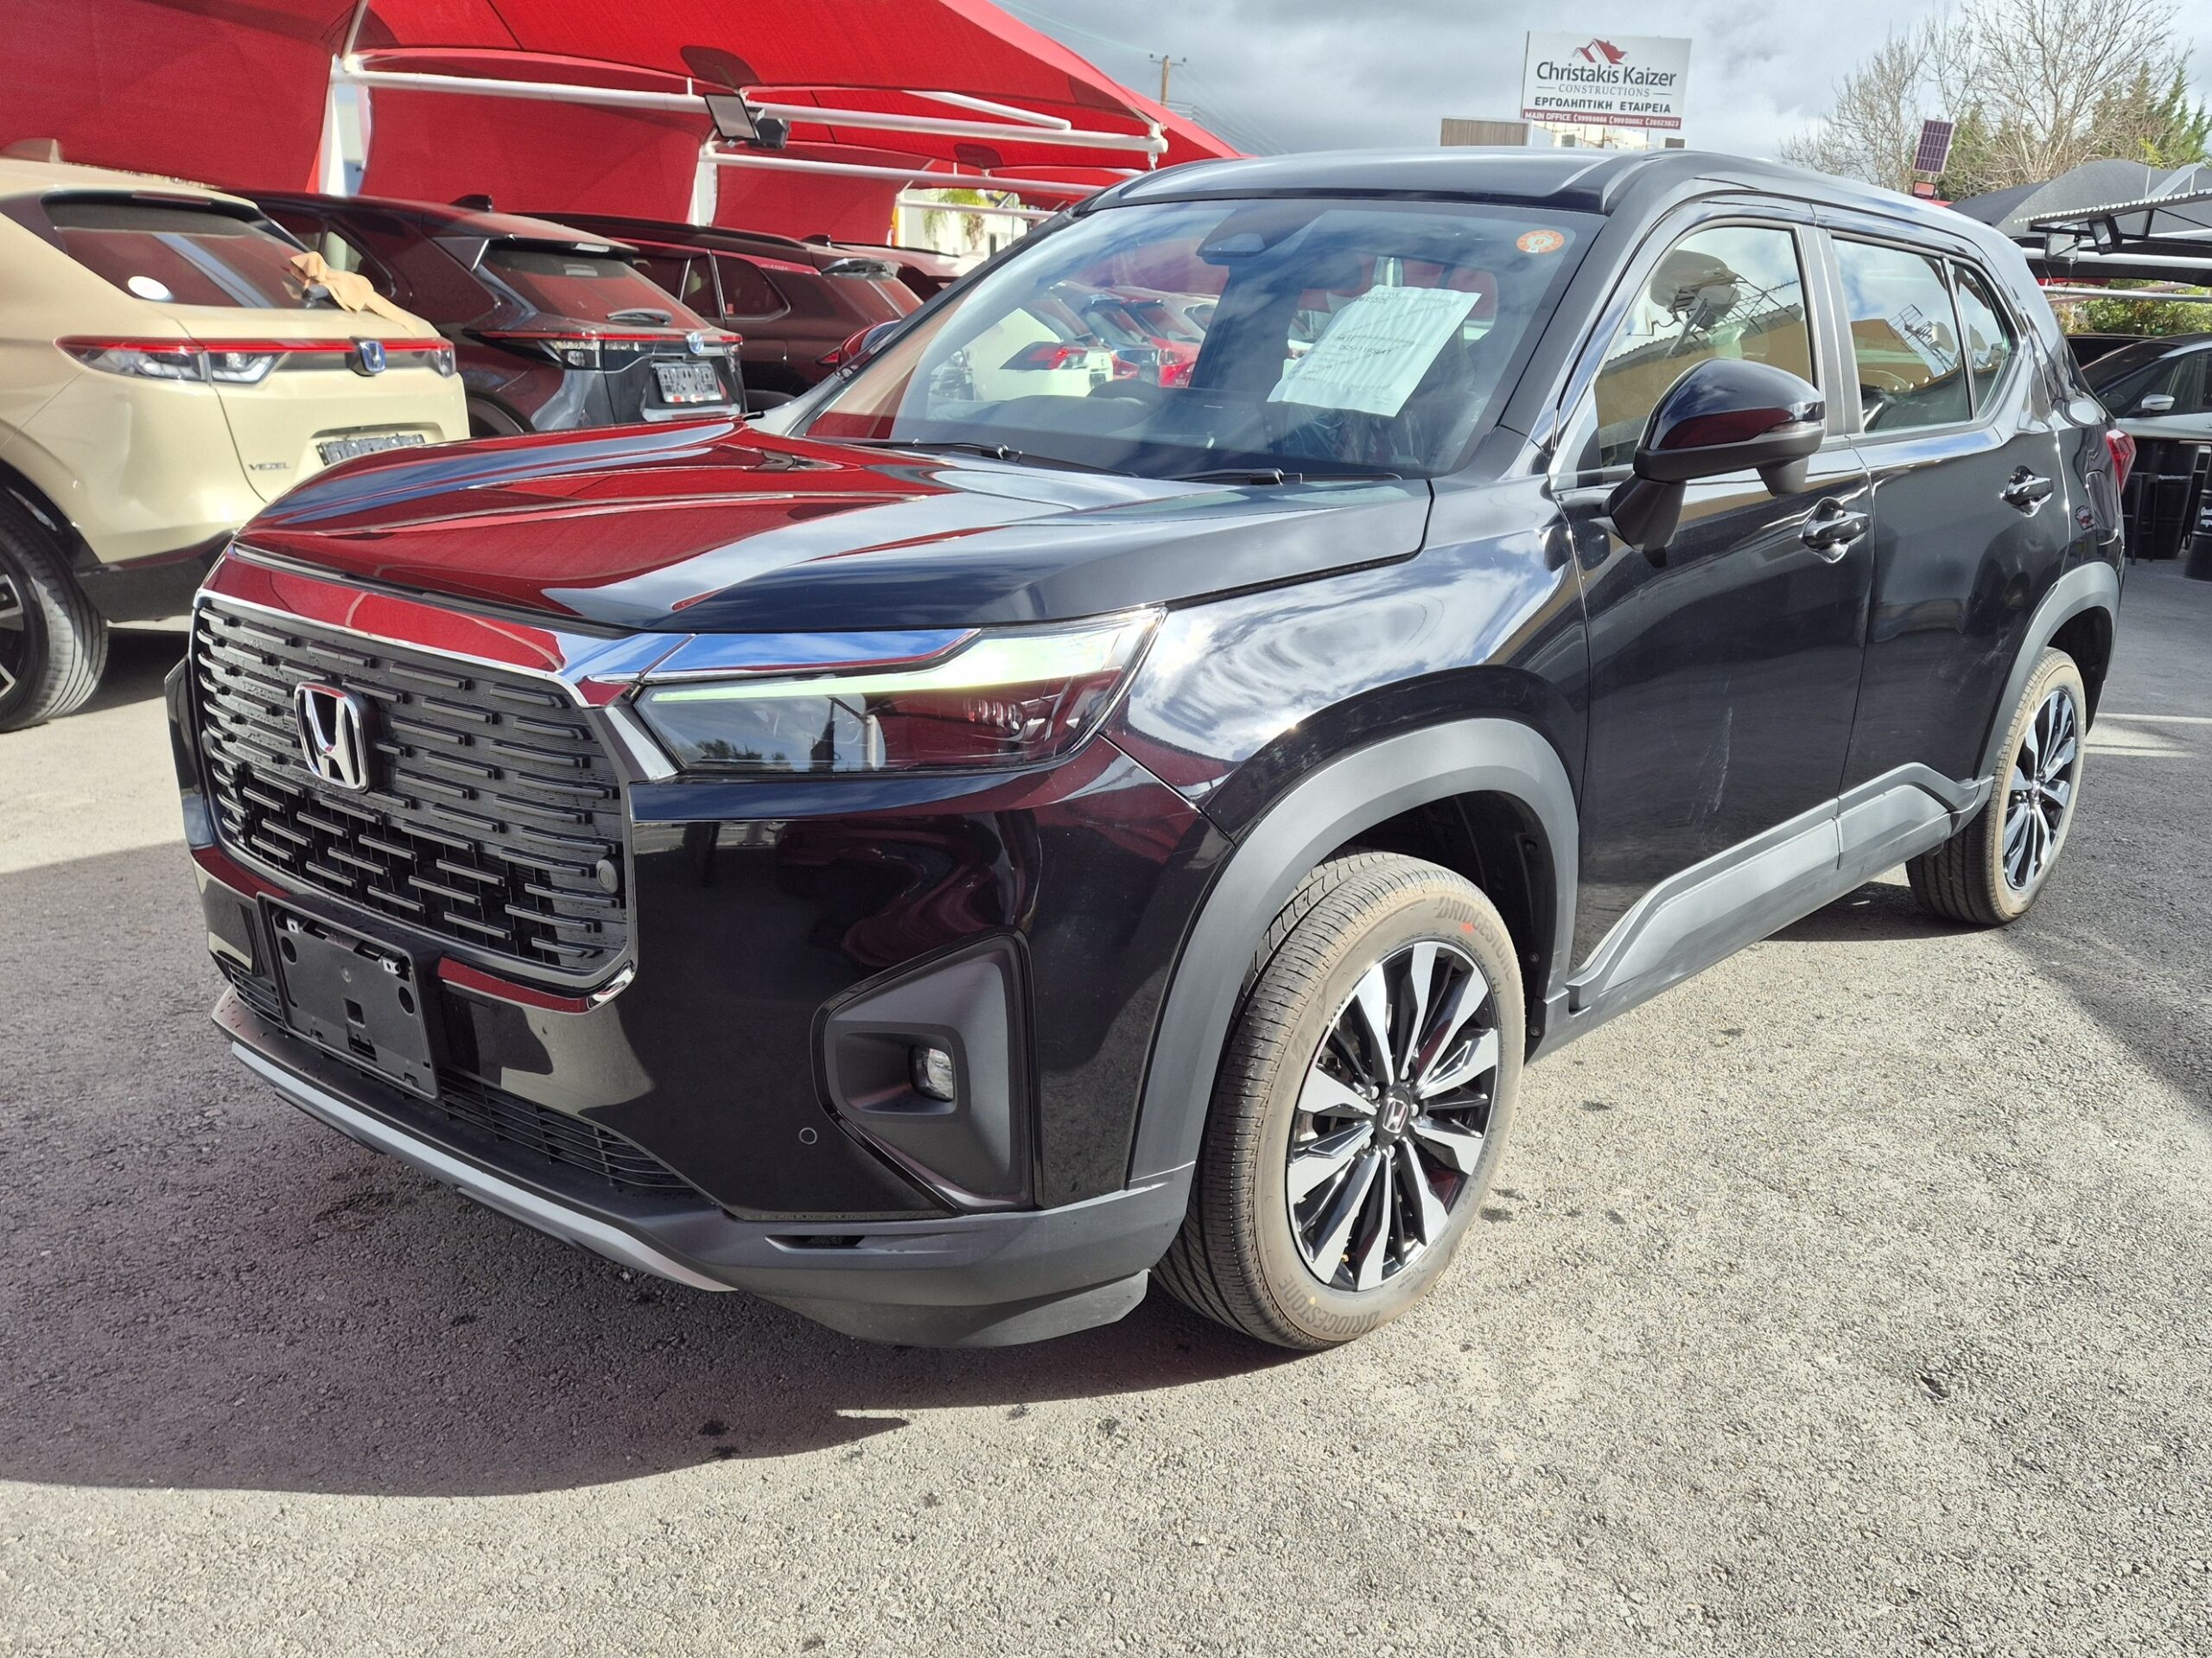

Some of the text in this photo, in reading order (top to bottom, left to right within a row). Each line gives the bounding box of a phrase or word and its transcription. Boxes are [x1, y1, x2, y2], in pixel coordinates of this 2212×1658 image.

[1536, 61, 1676, 86] Christakis Kaizer
[1559, 84, 1649, 97] CONSTRUCTIONS
[1535, 97, 1672, 113] ΕΡΓΟΛΗΠΤΙΚΗ ΕΤΑΙΡΕΙΑ
[1524, 111, 1545, 120] MAIN
[1546, 112, 1572, 122] OFFICE
[249, 462, 290, 471] VEZEL
[1434, 896, 1515, 981] BRIDGESTONE
[1277, 1274, 1382, 1336] BRIDGESTONE
